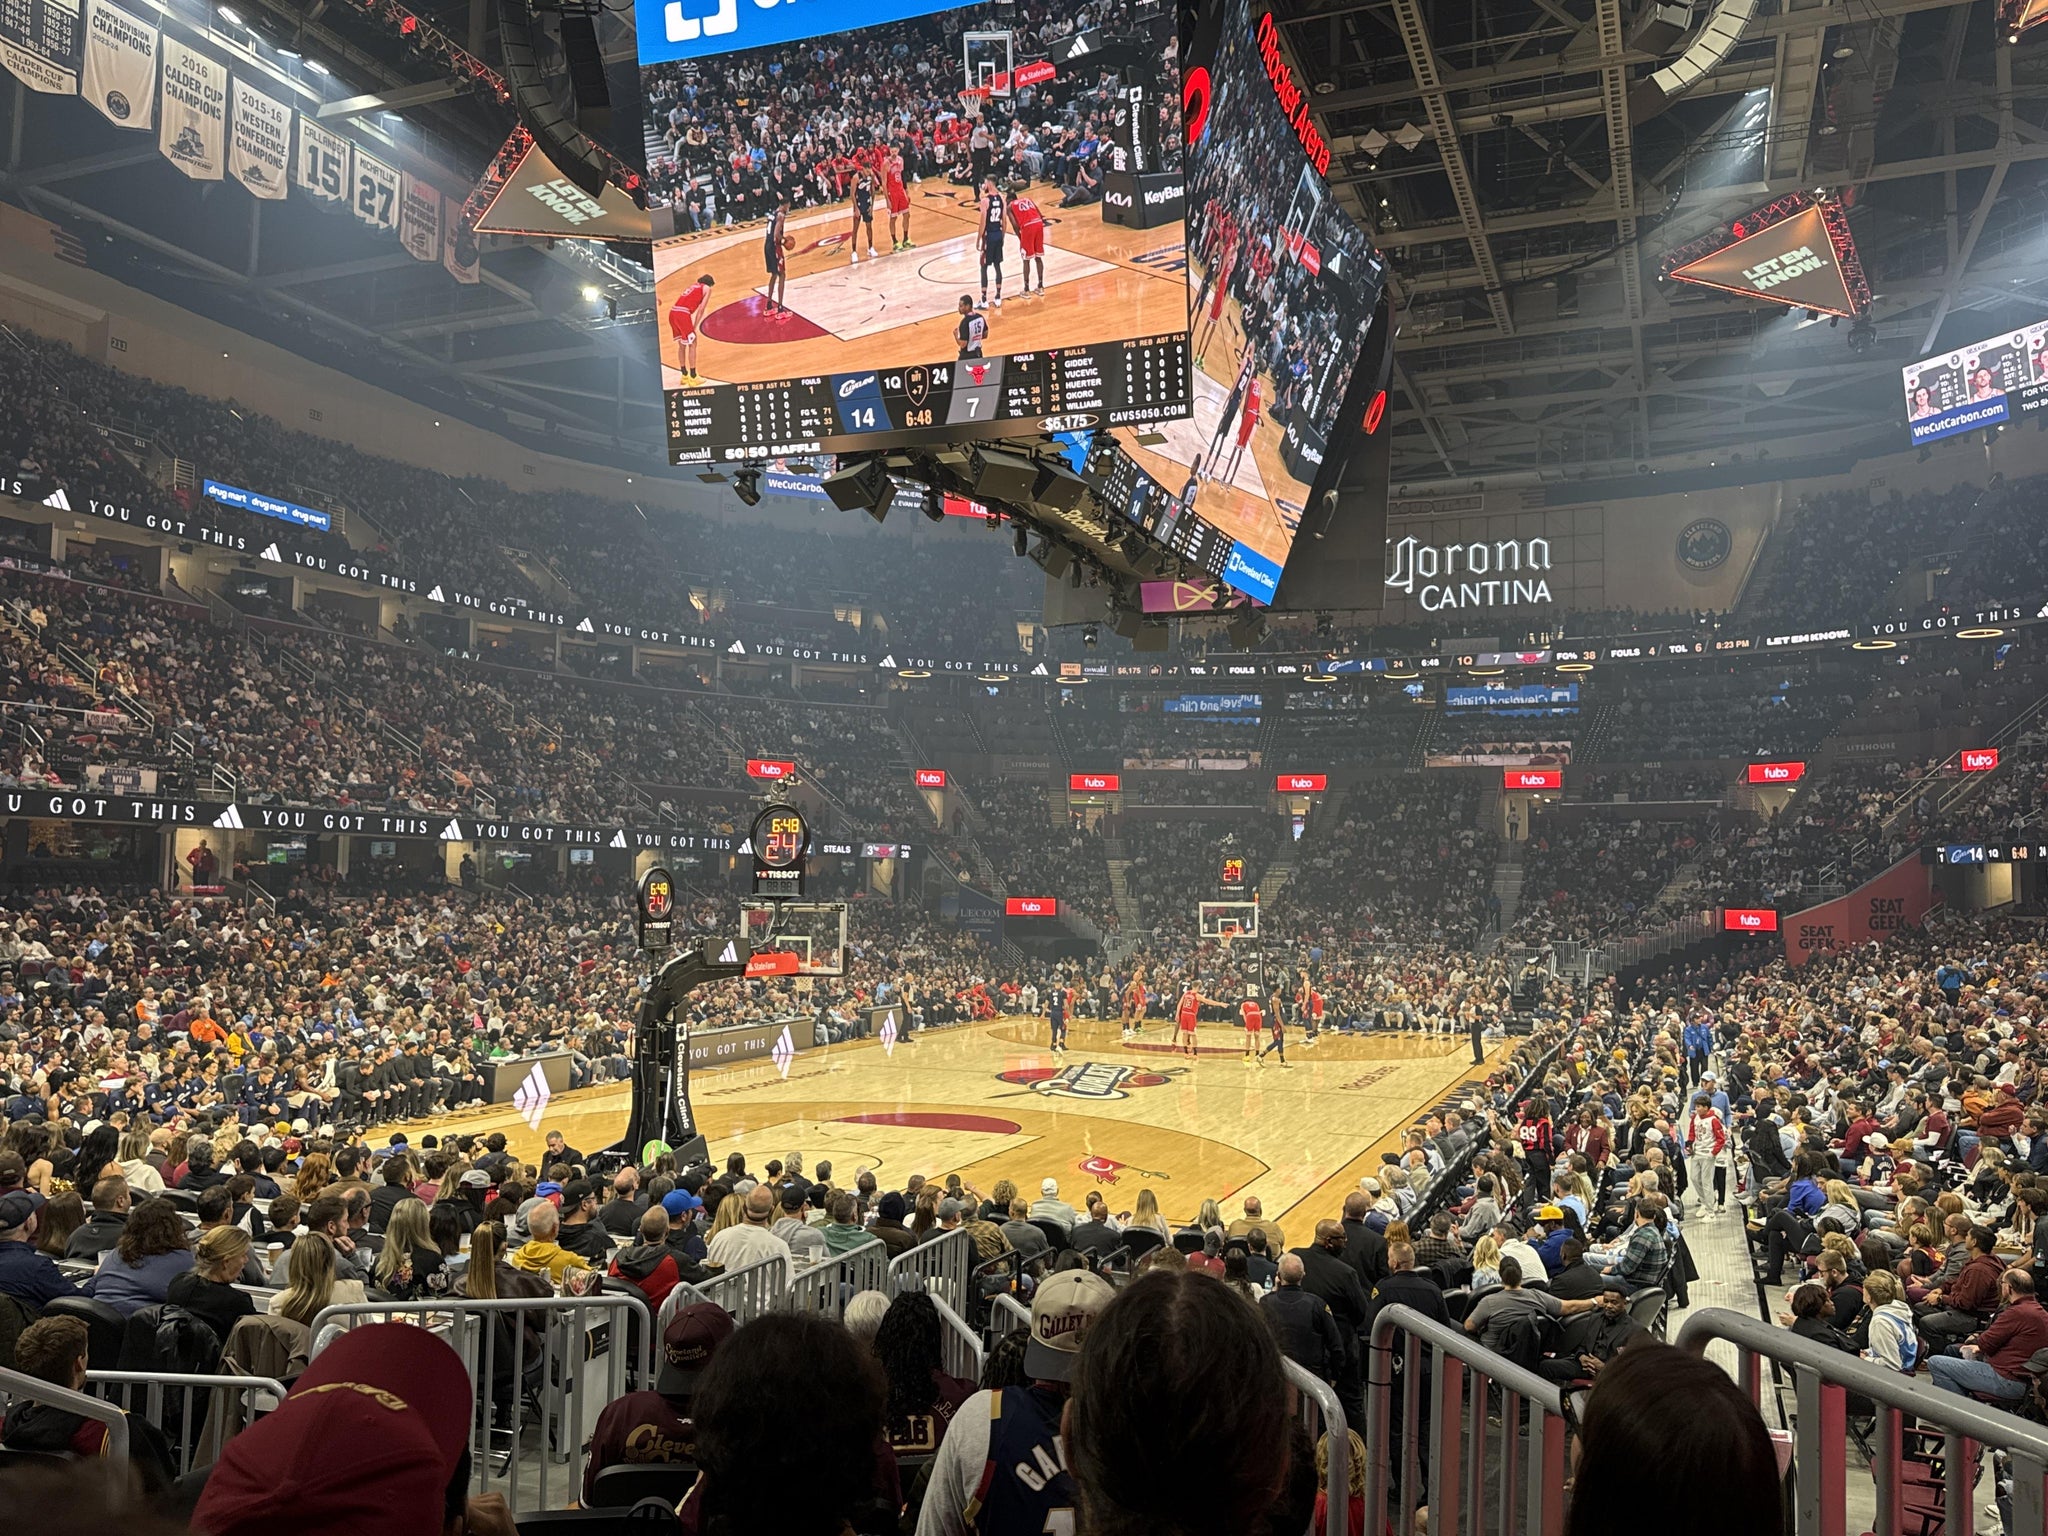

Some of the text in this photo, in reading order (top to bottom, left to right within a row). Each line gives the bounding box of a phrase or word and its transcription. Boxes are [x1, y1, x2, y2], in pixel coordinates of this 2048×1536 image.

[43, 16, 71, 36] 1952-53
[97, 7, 149, 42] NORTH DIVISION
[43, 26, 71, 46] 1953-54
[92, 16, 151, 57] CHAMPIONS
[6, 50, 63, 82] CALDER CUP
[182, 55, 208, 78] 2016
[7, 59, 62, 90] CHAMPIONS
[165, 64, 223, 103] CALDER CUP
[166, 82, 221, 120] CHAMPIONS
[242, 92, 282, 122] 2015-16
[1264, 27, 1330, 177] Rocket Arena
[242, 109, 280, 139] WESTERN
[235, 121, 286, 157] CONFERENCE
[304, 126, 346, 157] CALLANDER
[1132, 103, 1142, 170] Cleveland Clinic
[236, 137, 283, 170] CHAMPIONS
[308, 145, 341, 195] 15
[359, 175, 393, 224] 27
[526, 184, 590, 226] KNOW.
[990, 208, 1000, 222] 32
[1742, 246, 1813, 280] LET EM
[1753, 259, 1828, 290] KNOW.
[1064, 348, 1086, 356] BULLS
[1123, 341, 1136, 349] PTS
[1173, 334, 1185, 342] FLS
[1013, 354, 1034, 362] FOULS
[1065, 358, 1093, 368] GIDDEY
[933, 368, 948, 385] 24
[1065, 368, 1098, 379] VUCEVIC
[802, 378, 821, 386] FOULS
[884, 376, 901, 389] 1Q
[1066, 378, 1102, 389] HUERTER
[682, 389, 715, 397] CAVALIERS
[912, 385, 922, 395] +7
[1066, 390, 1094, 400] OKORO
[2022, 388, 2038, 398] FOR
[683, 399, 701, 407] BALL
[967, 398, 979, 417] 7
[1066, 400, 1102, 411] WILLIAMS
[2022, 400, 2038, 411] TWO
[684, 408, 711, 416] MOBLEY
[851, 408, 874, 428] 14
[906, 409, 932, 426] 6:48
[1110, 404, 1186, 422] CAVS5050.COM
[685, 418, 711, 426] HUNTER
[1045, 414, 1087, 432] $6,175
[1914, 405, 2003, 437] WeCutCarbon.com
[685, 428, 708, 436] TYSON
[680, 447, 711, 460] oswald
[771, 443, 820, 456] RAFFLE
[208, 485, 326, 526] drug mart drug mart drug mart
[1132, 500, 1141, 516] 14
[89, 500, 246, 549] YOU GOT THIS
[1160, 522, 1168, 537] 7
[1385, 535, 1552, 593] Corona
[295, 552, 416, 592] YOU GOT THIS
[1239, 560, 1275, 589] Cleveland Clinic
[1420, 580, 1551, 611] CANTINA
[455, 593, 564, 624] YOU GOT THIS
[1872, 608, 2020, 635] YOU GOT THIS
[605, 624, 716, 648] YOU GOT THIS
[1669, 644, 1688, 654] TOL
[1736, 640, 1749, 648] PM
[756, 645, 867, 664] YOU GOT THIS
[1458, 656, 1472, 665] 1Q
[1583, 651, 1596, 660] 38
[1611, 648, 1640, 658] FOULS
[908, 658, 1018, 672] YOU GOT THIS
[1360, 661, 1372, 670] 14
[1421, 659, 1439, 667] 6:48
[1846, 742, 1896, 752] LITEHOUSE
[1966, 754, 1993, 767] fubo
[761, 764, 781, 775] fubo
[1764, 767, 1789, 779] fubo
[112, 775, 132, 784] WTAM
[920, 773, 941, 783] fubo
[1084, 778, 1105, 788] fubo
[1291, 778, 1313, 788] fubo
[1520, 775, 1545, 785] fubo
[50, 798, 195, 821] GOT THIS
[263, 810, 428, 834] YOU GOT THIS
[772, 818, 799, 833] 6:48
[476, 823, 600, 844] YOU GOT THIS
[636, 834, 730, 850] YOU GOT THIS
[766, 834, 796, 859] 24
[824, 845, 851, 854] STEALS
[868, 846, 873, 855] 3
[1970, 847, 1983, 861] 14
[1988, 849, 1998, 857] 1Q
[2012, 847, 2027, 859] 6:48
[1226, 860, 1241, 868] 6:48
[1224, 868, 1241, 881] 24
[650, 883, 668, 895] 6:48
[649, 897, 664, 912] 24
[1022, 902, 1040, 911] fubo
[1870, 898, 1904, 913] SEAT
[960, 909, 1000, 917] LECOM
[1740, 915, 1760, 926] fubo
[1869, 915, 1907, 931] GEEK
[1801, 926, 1834, 937] SEAT
[1799, 938, 1835, 950] GEEK
[689, 1038, 766, 1059] YOU GOT THIS
[677, 1043, 689, 1129] Cleveland Clinic
[1520, 1125, 1537, 1141] 89
[1040, 1313, 1083, 1339] GALLEY
